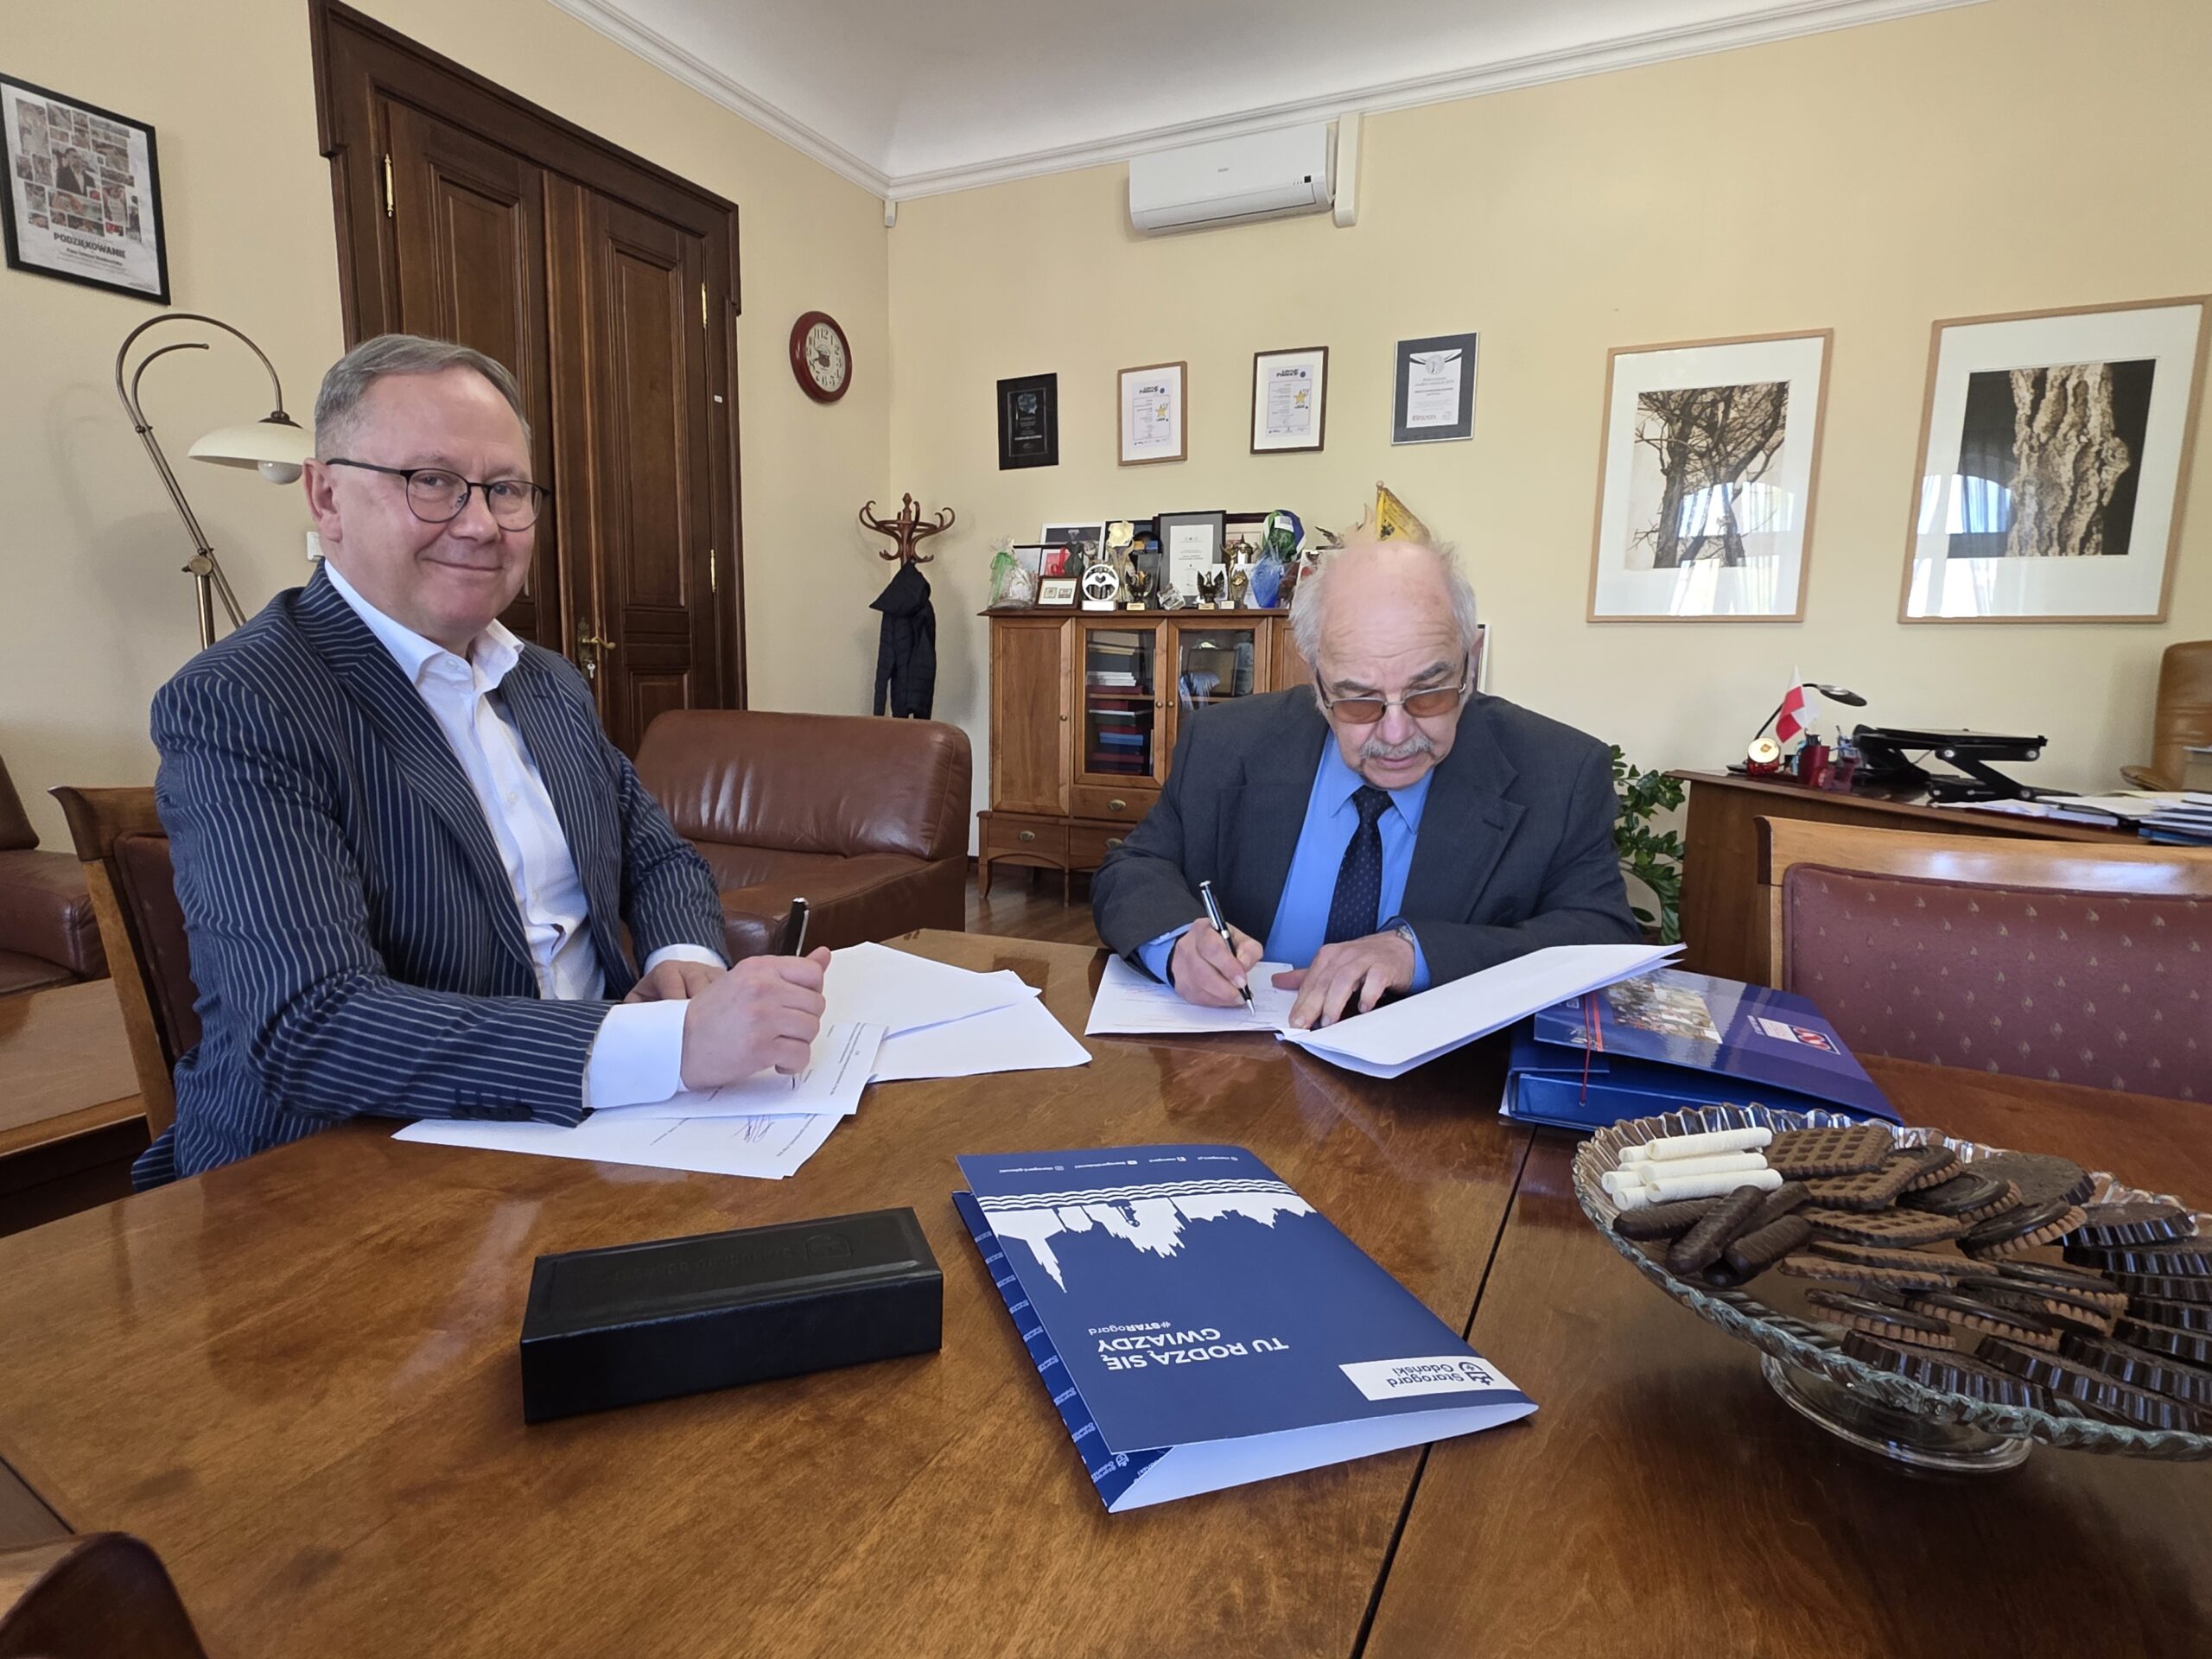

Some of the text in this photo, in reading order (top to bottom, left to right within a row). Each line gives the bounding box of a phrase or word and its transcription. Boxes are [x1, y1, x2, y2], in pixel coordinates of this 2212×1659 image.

[54, 232, 126, 258] PODZIĘKOWANIE
[1088, 1321, 1172, 1336] #STARogard
[1097, 1327, 1221, 1353] GWIAZDY
[1100, 1337, 1289, 1370] TU RODZĄ SIĘ
[1392, 1363, 1454, 1376] Gdański
[1386, 1373, 1464, 1388] Starogard
